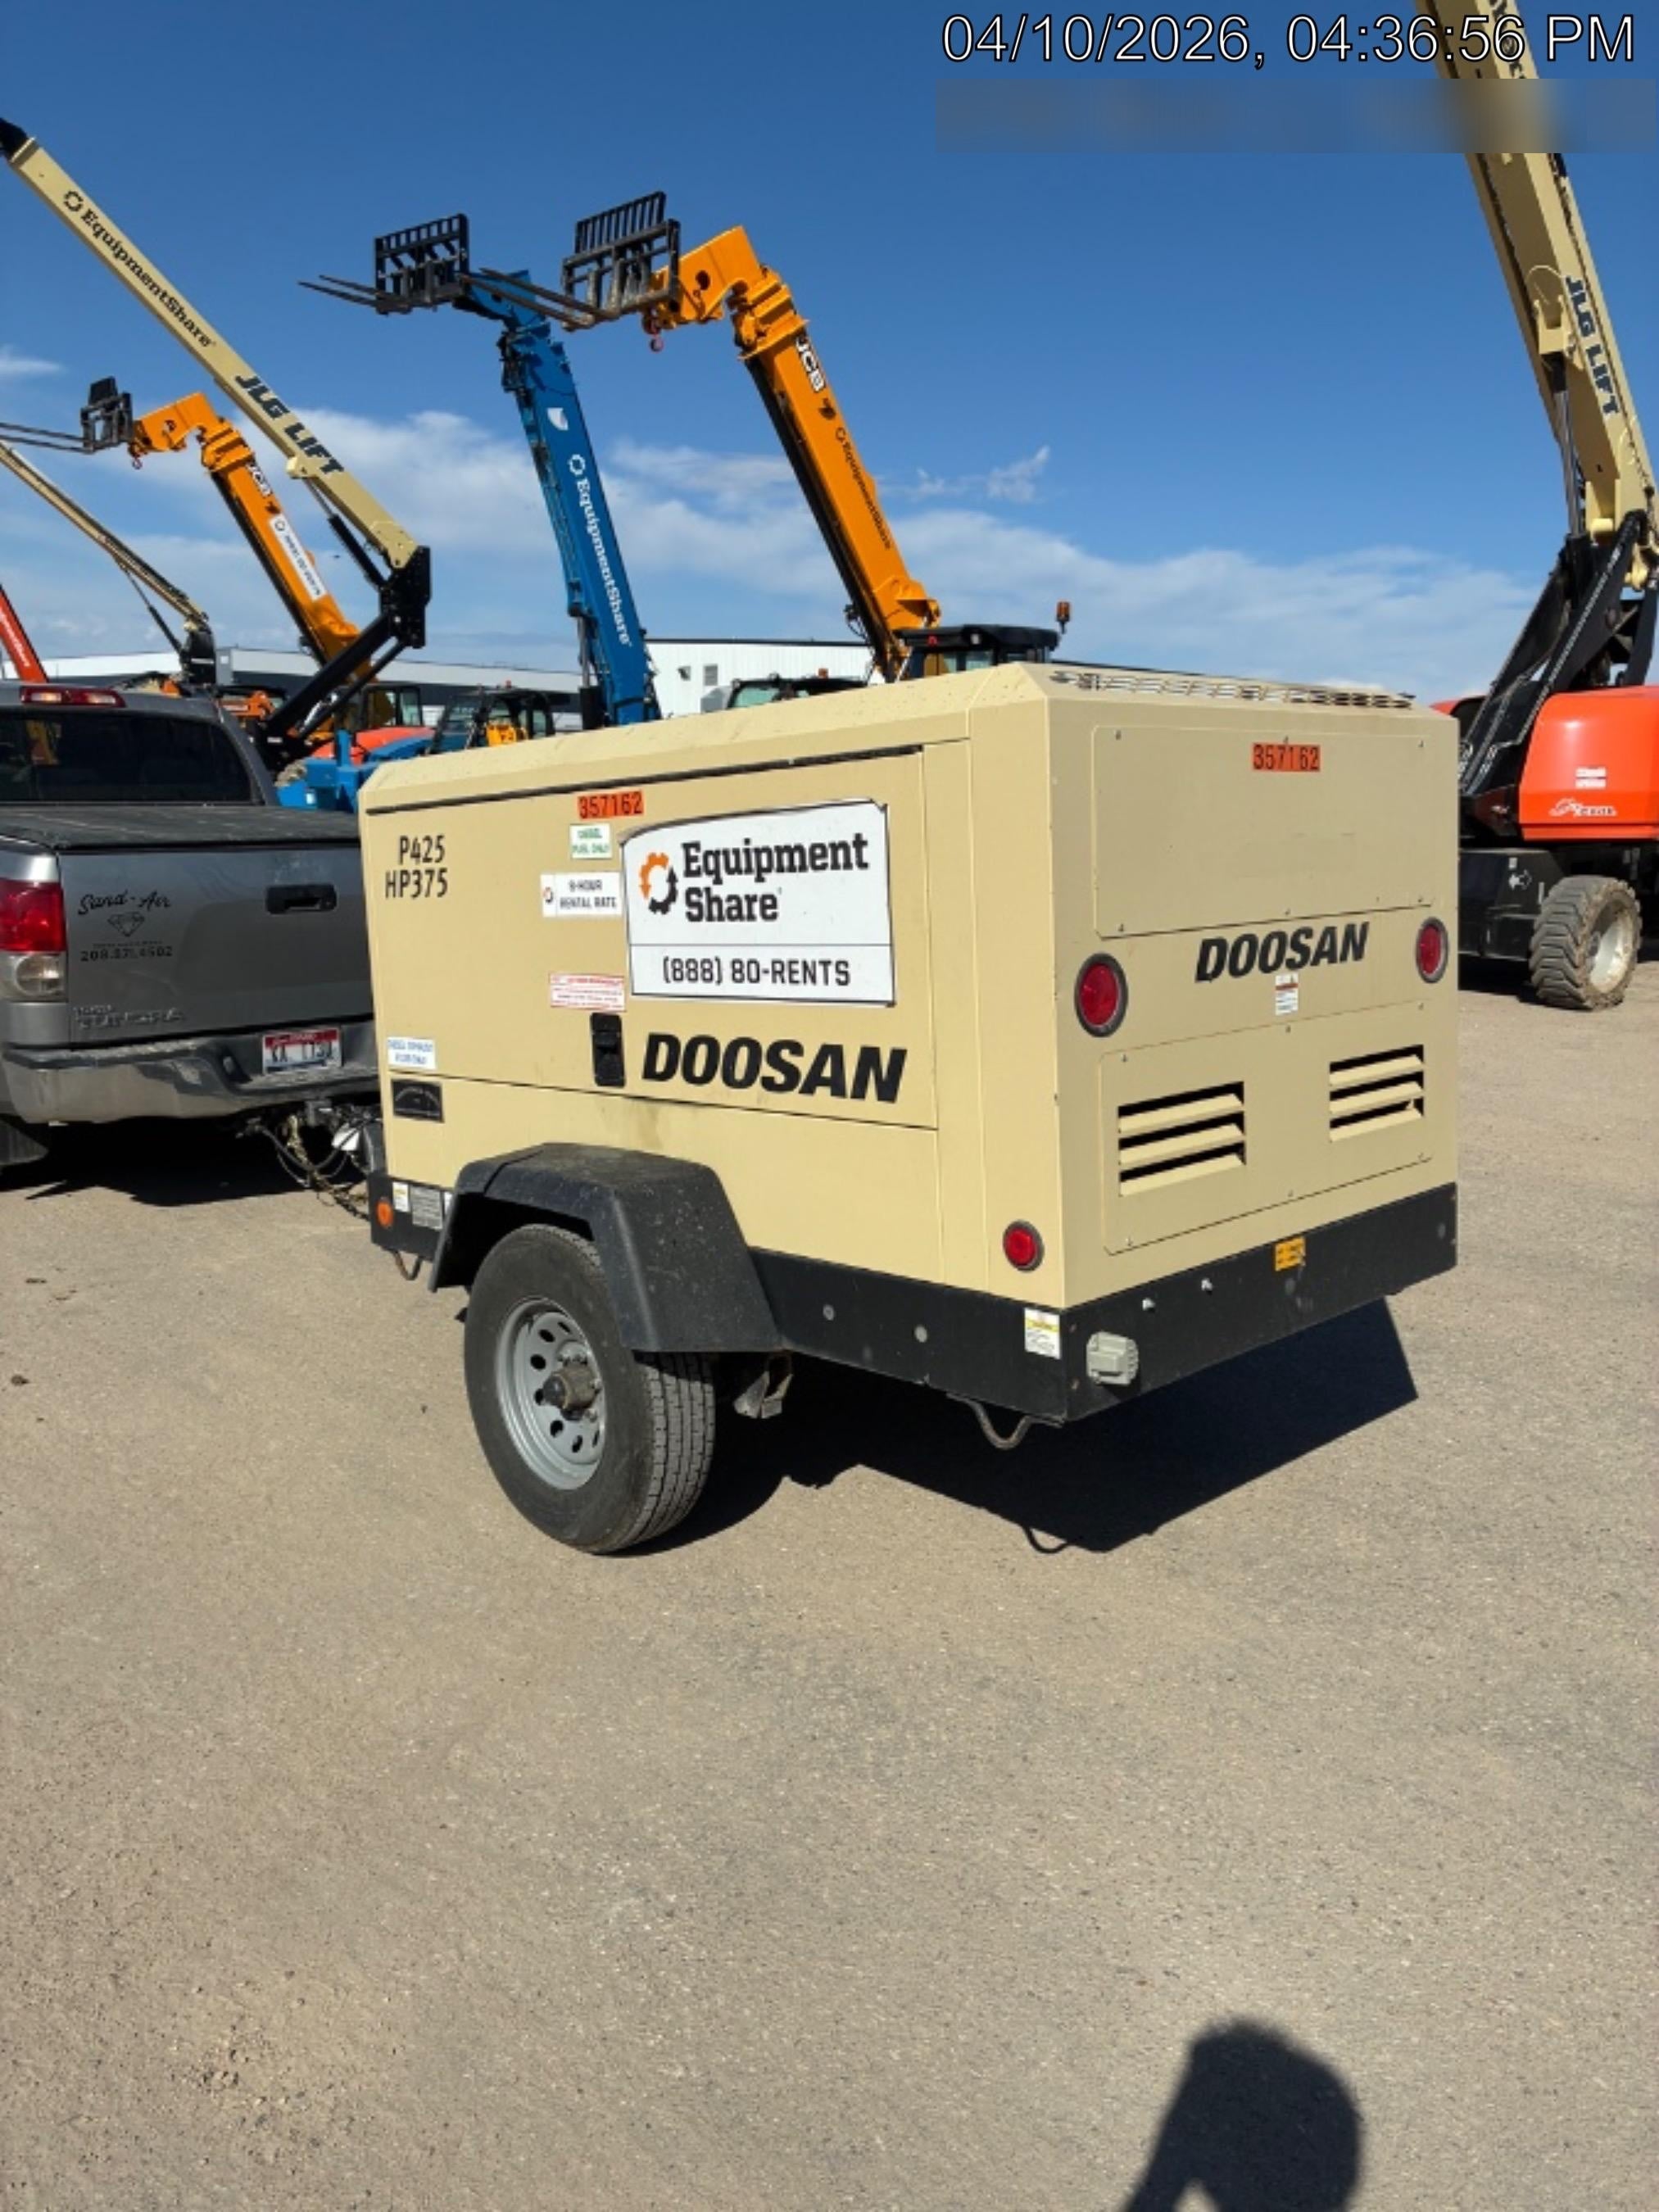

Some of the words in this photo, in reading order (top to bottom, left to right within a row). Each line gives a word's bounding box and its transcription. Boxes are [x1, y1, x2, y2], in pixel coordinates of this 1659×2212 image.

[81, 208, 211, 347] EquipmentShare
[796, 335, 827, 392] JCB
[1566, 274, 1596, 337] JLG
[1585, 343, 1620, 414] LIFT
[235, 375, 291, 419] JLG
[284, 422, 345, 475] LIFT
[1253, 744, 1320, 770] 357162
[578, 791, 643, 819] 357162
[398, 834, 446, 865] P425
[682, 832, 868, 886] Equipment
[385, 868, 448, 900] HP375
[594, 895, 617, 909] RATE
[686, 886, 779, 923] Share
[662, 955, 722, 986] (888)
[730, 958, 851, 986] 80-RENTS
[1194, 921, 1371, 983] DOOSAN
[642, 1032, 908, 1104] DOOSAN
